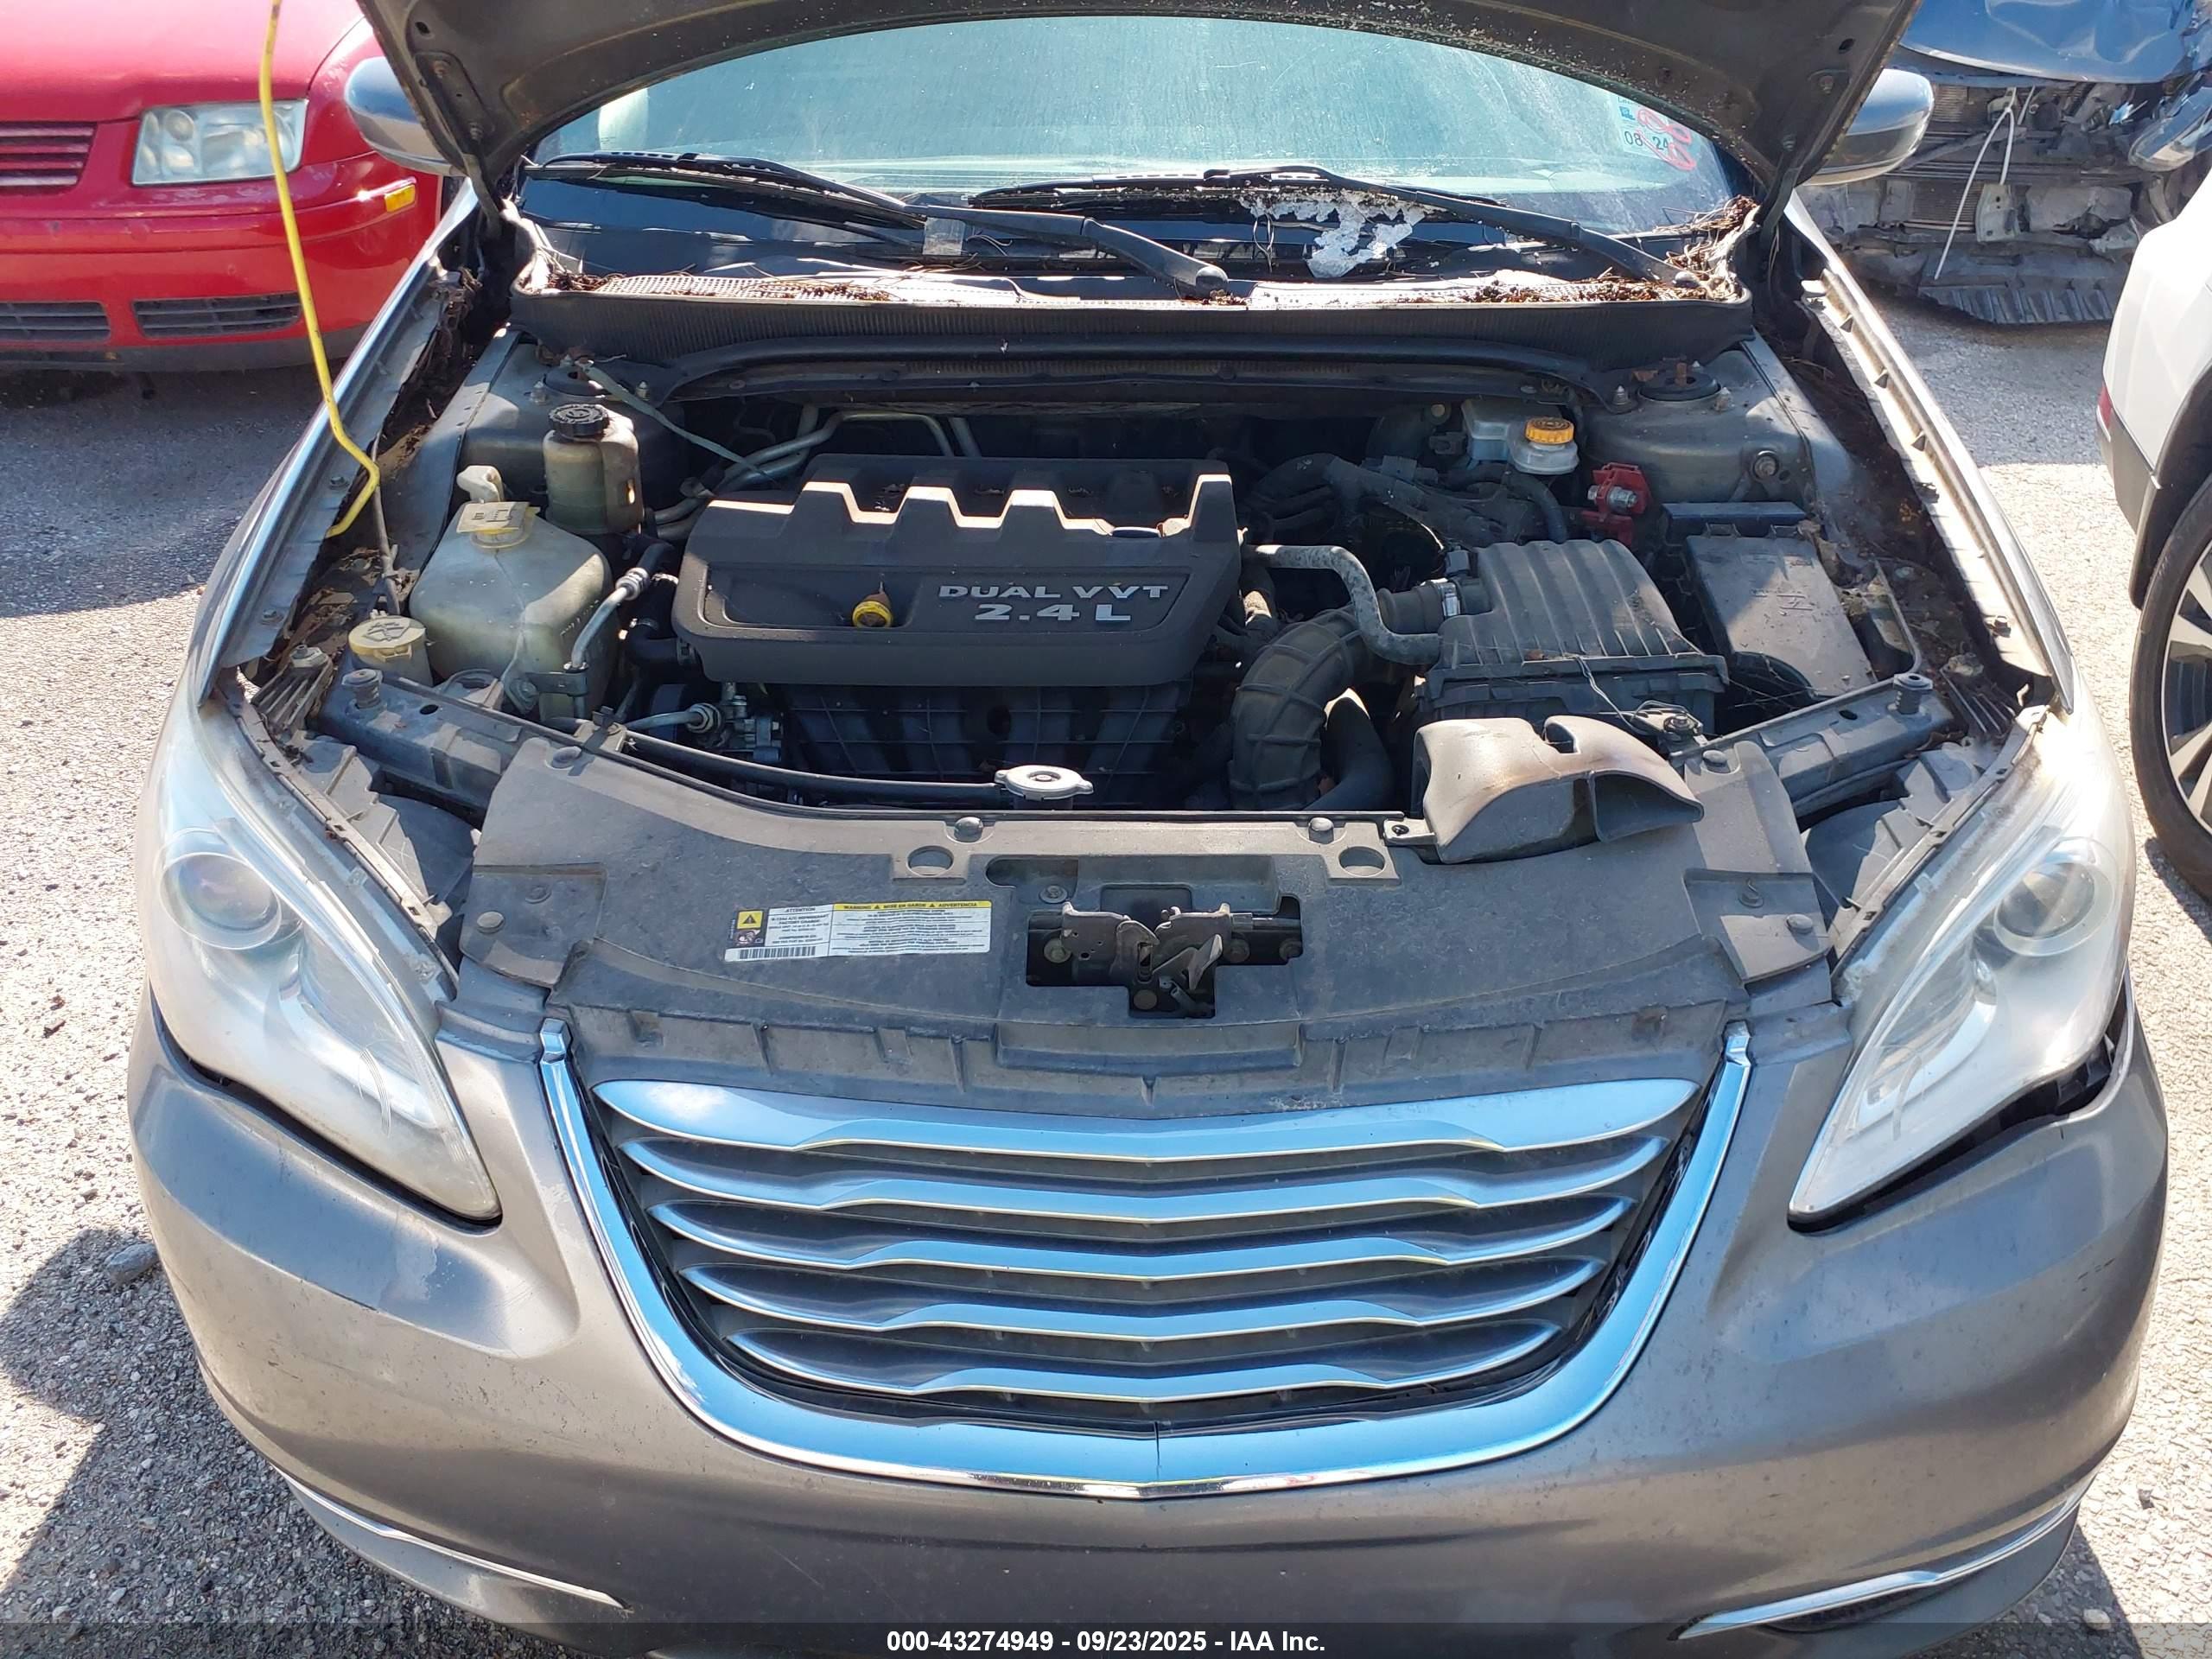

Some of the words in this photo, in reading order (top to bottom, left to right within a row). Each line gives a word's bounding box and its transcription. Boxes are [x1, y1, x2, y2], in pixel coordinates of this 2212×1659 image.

[1624, 130, 1643, 147] 08
[938, 585, 1061, 599] DUAL
[1071, 585, 1169, 599] VVT
[975, 604, 1080, 621] 2.4
[1095, 604, 1131, 621] L
